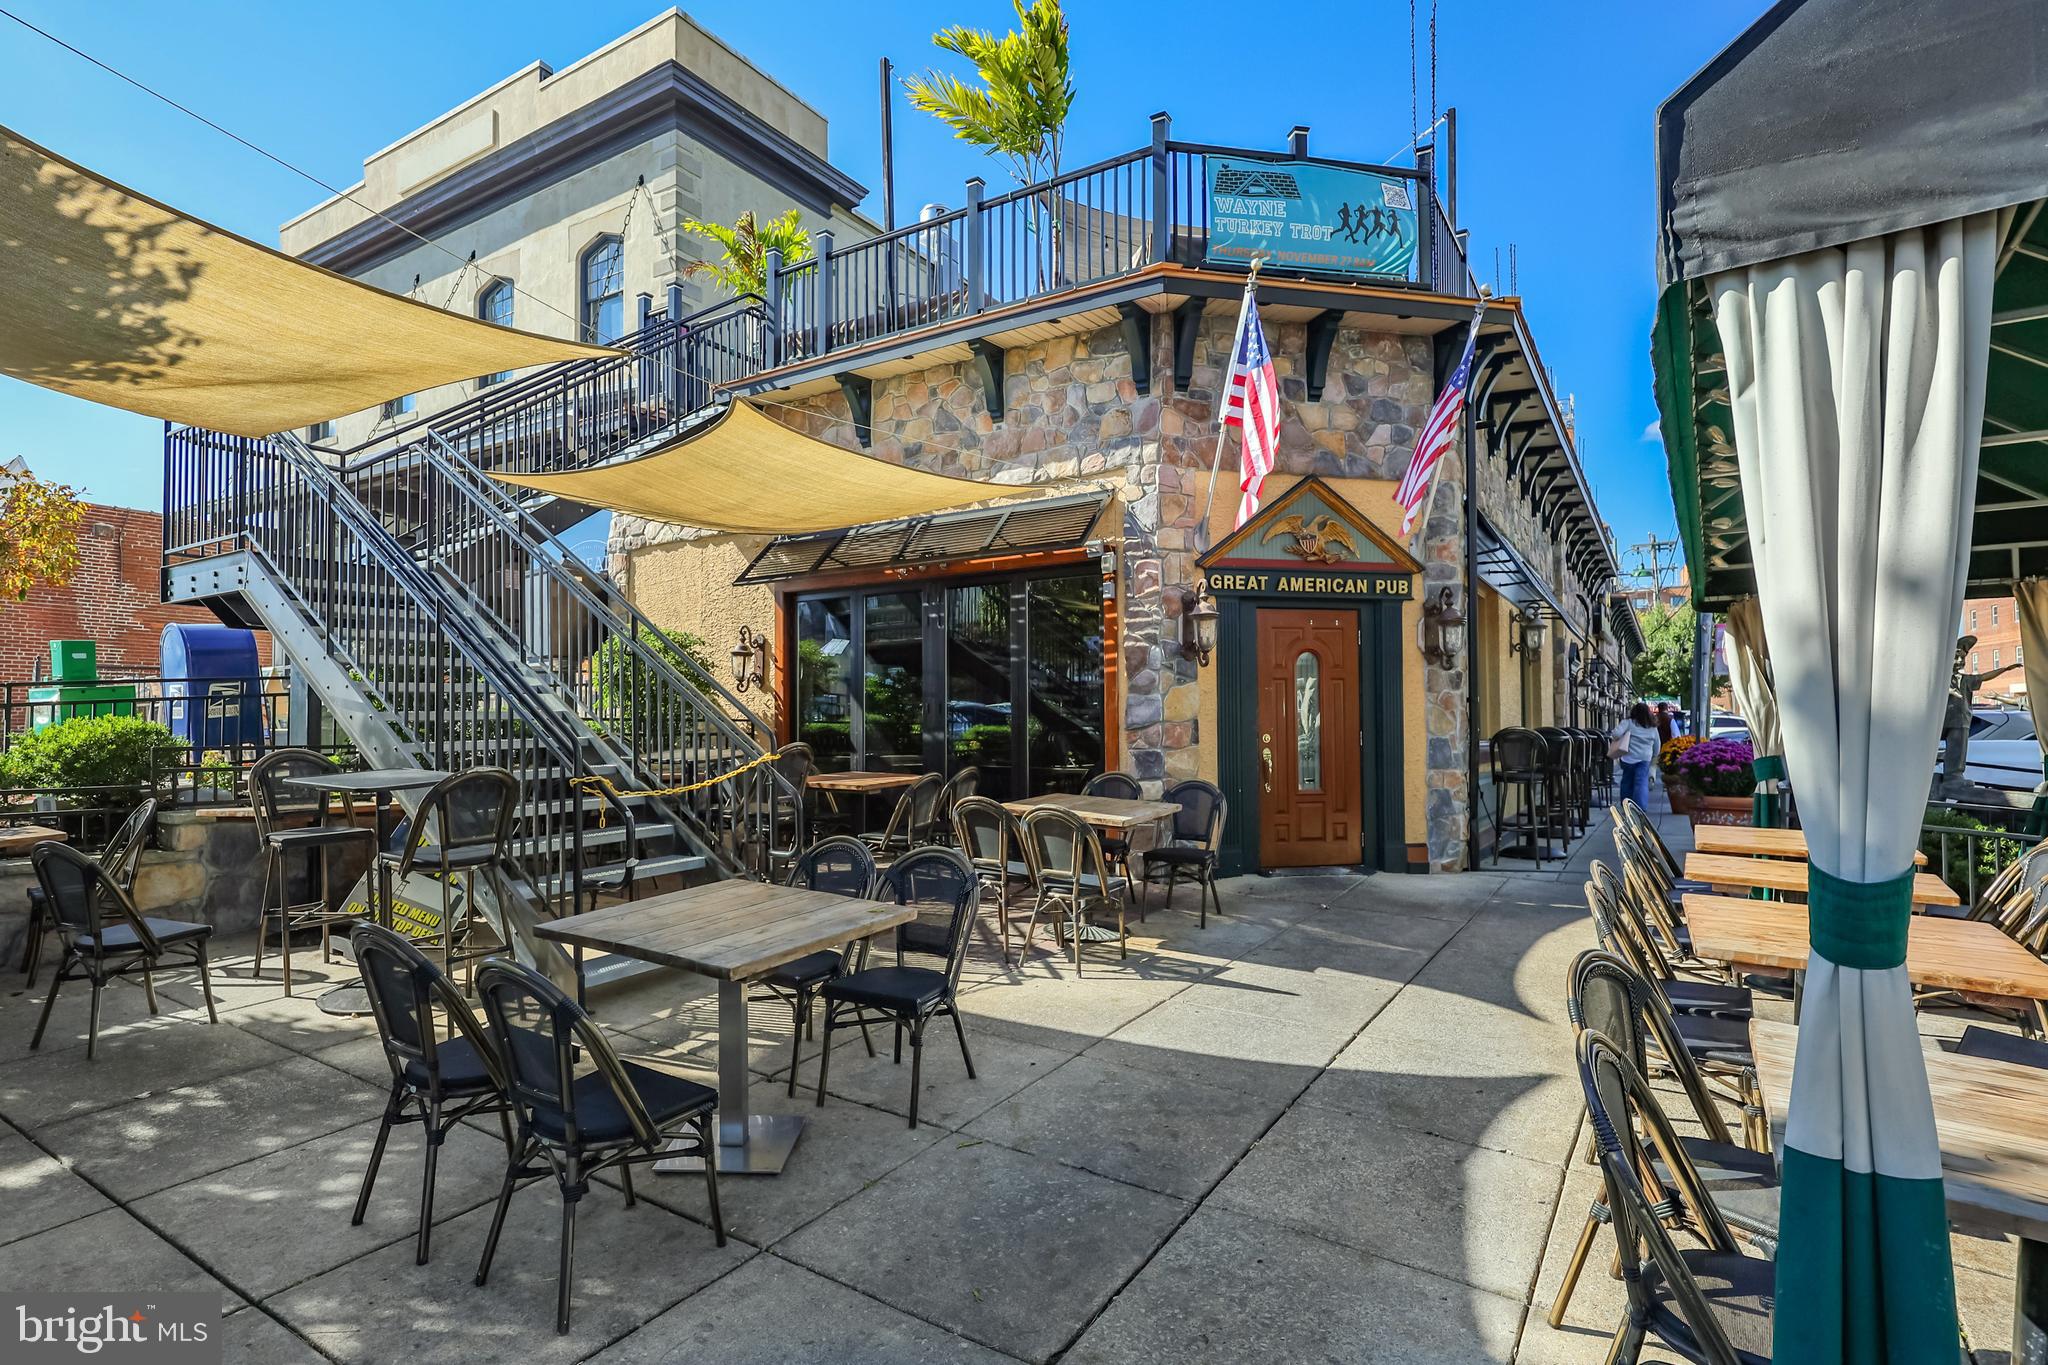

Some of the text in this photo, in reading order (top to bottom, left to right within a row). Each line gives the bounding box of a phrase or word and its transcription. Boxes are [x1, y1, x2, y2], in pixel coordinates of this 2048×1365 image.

[1213, 196, 1287, 217] WAYNE
[1214, 217, 1333, 242] TURKEY TROT
[1210, 574, 1409, 595] GREAT AMERICAN PUB
[408, 907, 441, 928] MENU
